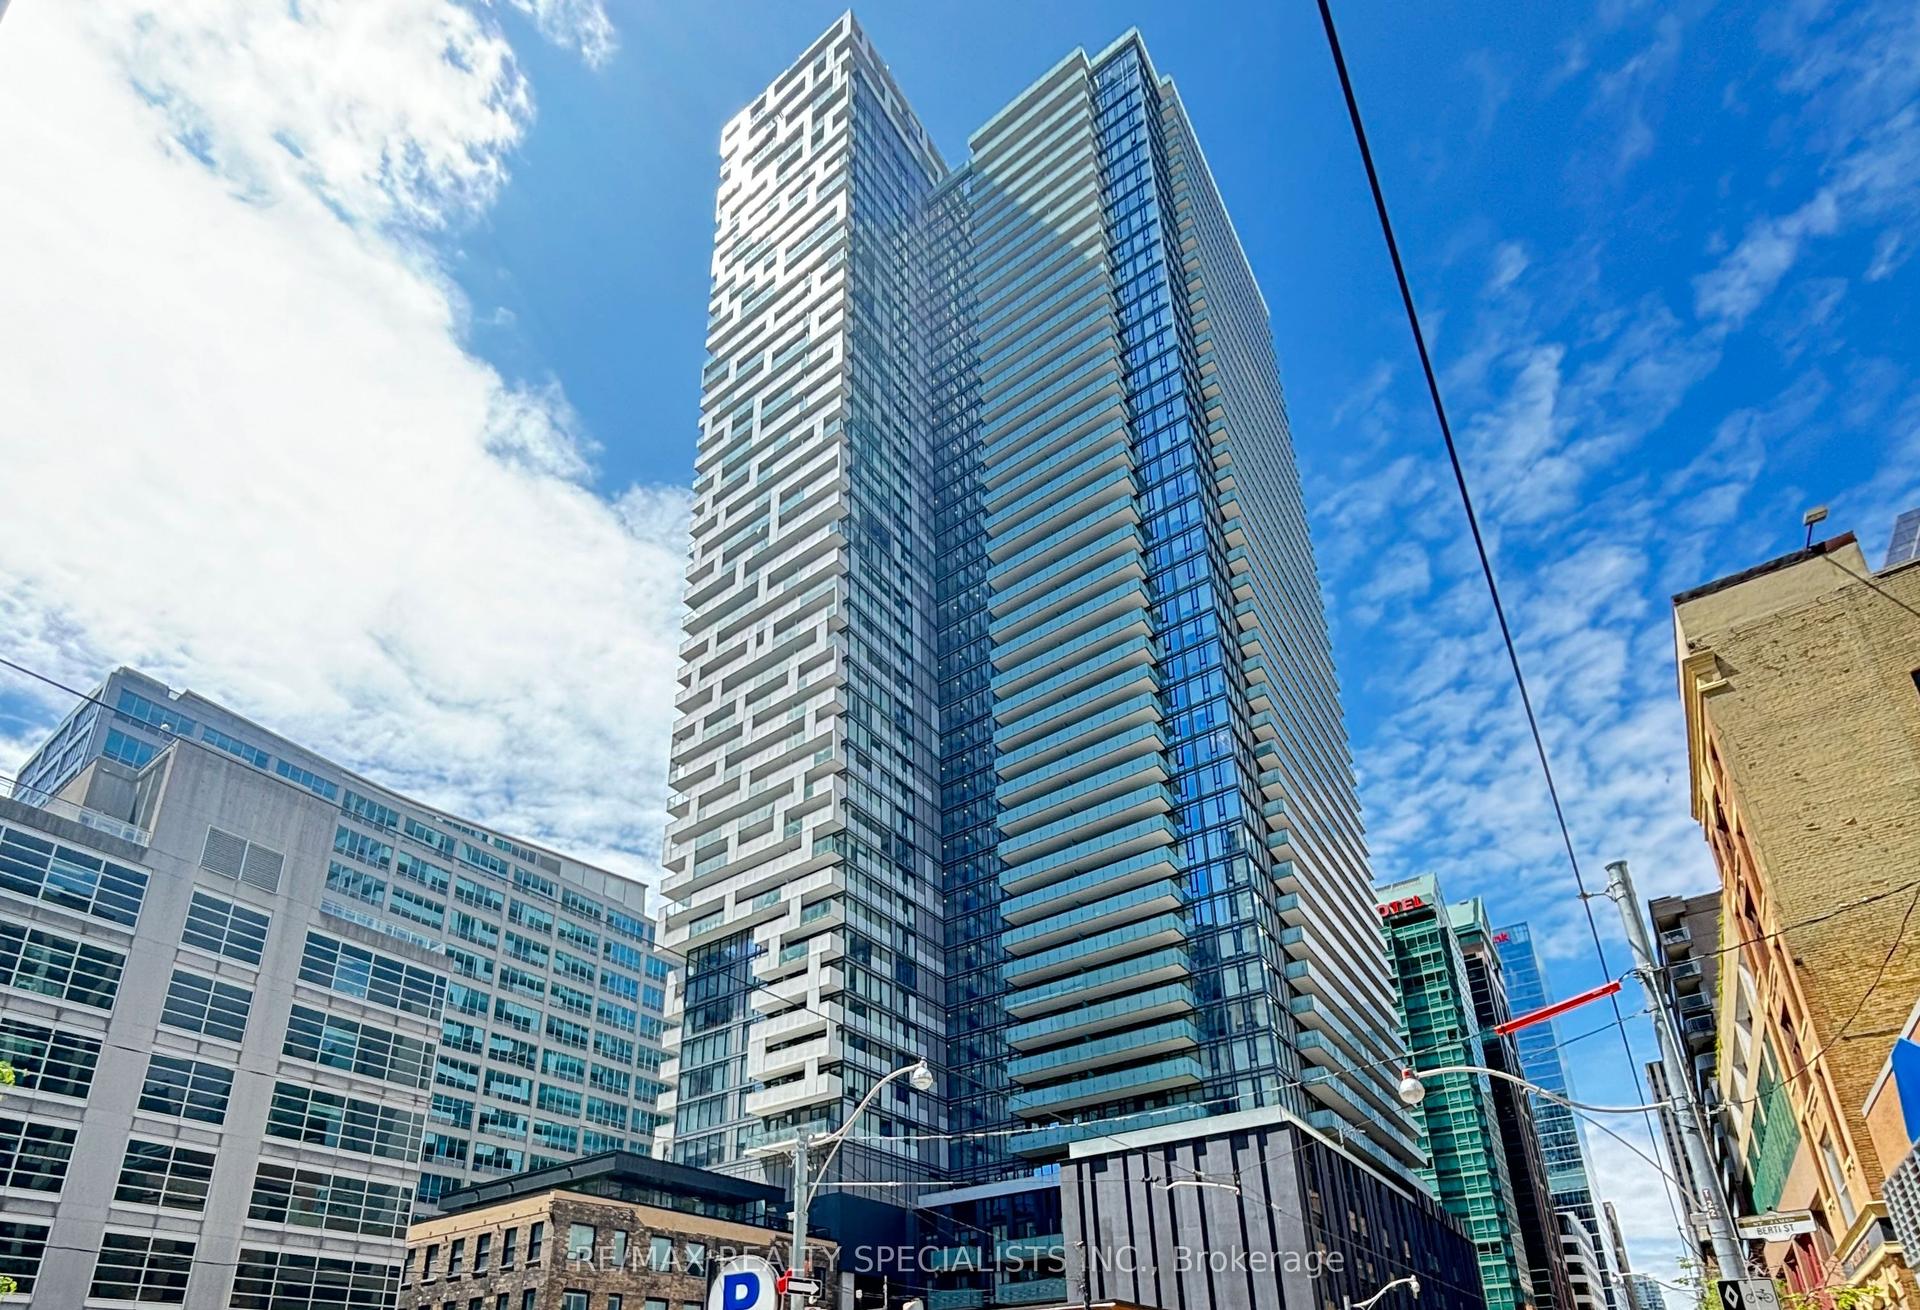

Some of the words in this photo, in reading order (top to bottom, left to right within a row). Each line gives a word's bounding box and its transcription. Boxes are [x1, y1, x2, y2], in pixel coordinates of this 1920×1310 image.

[1376, 895, 1424, 917] OTEL
[1757, 1225, 1782, 1235] BERTI
[1783, 1224, 1795, 1232] ST
[723, 1272, 760, 1310] P
